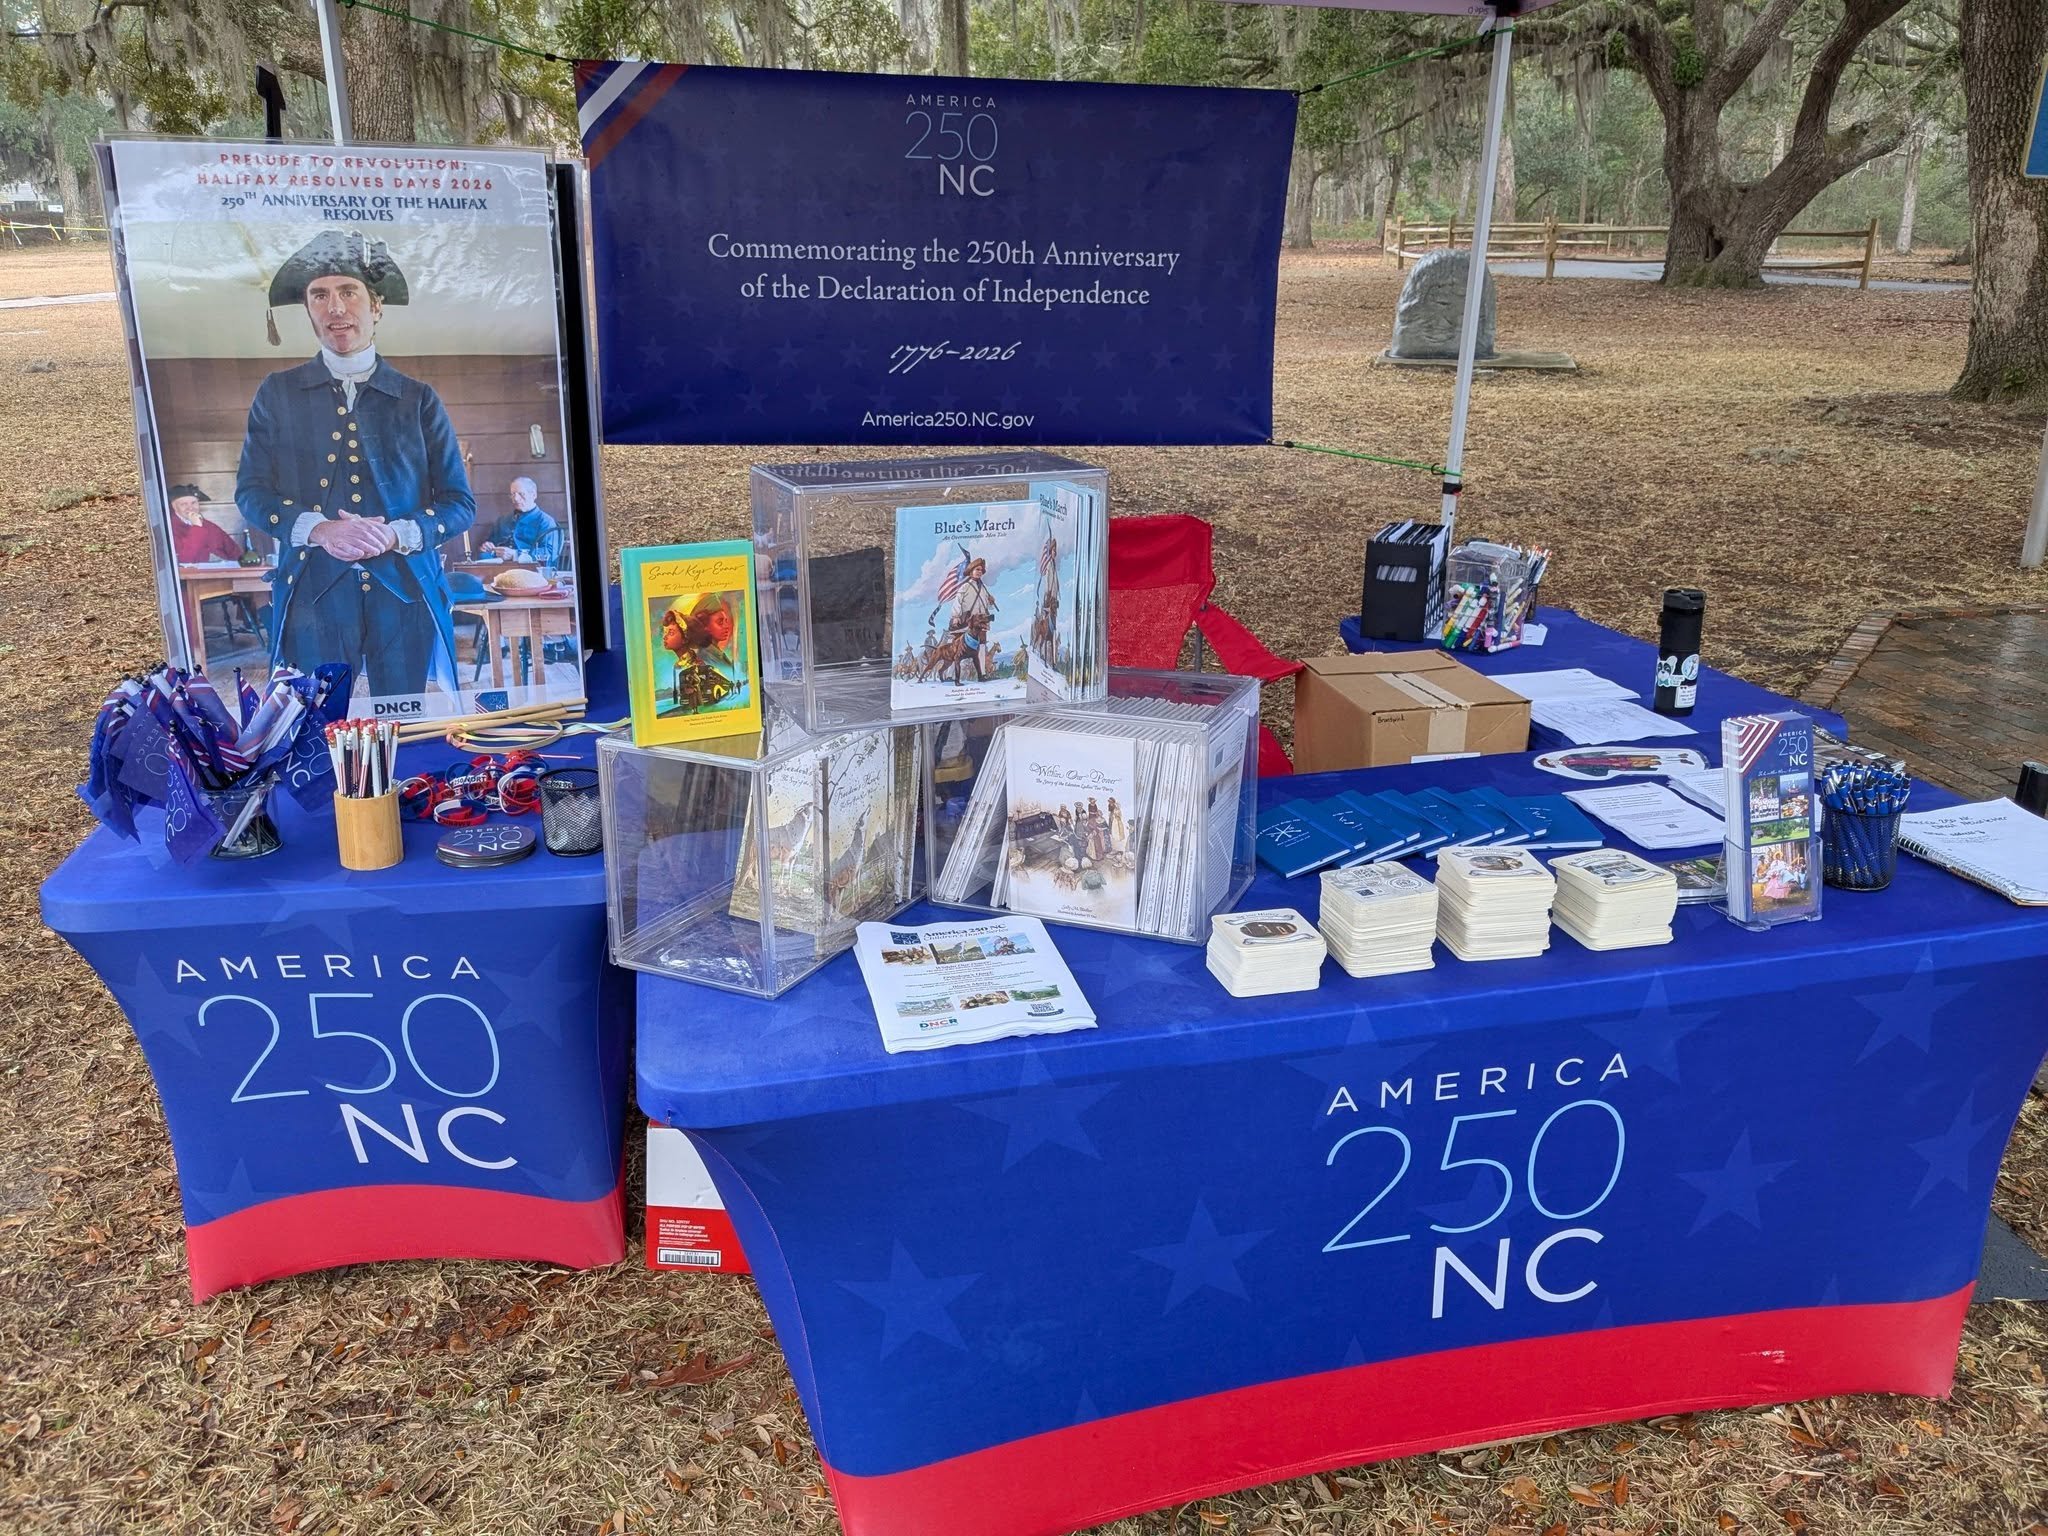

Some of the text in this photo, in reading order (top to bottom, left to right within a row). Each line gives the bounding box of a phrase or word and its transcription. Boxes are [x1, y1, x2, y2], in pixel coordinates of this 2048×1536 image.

[906, 94, 996, 109] AMERICA
[904, 111, 998, 161] 250
[220, 154, 468, 171] PRELUDE TO REVOLUTION:
[197, 173, 493, 191] HALIFAX RESOLVES DAYS 2026
[939, 163, 996, 197] NC
[262, 193, 367, 209] ANNIVERSARY
[371, 196, 392, 209] OF
[394, 196, 424, 209] THE
[427, 197, 488, 210] HALIFAX
[323, 209, 394, 222] RESOLVES
[707, 232, 1181, 276] Commemorating the 250th Anniversary
[740, 274, 1151, 312] of the Declaration of Independence
[861, 411, 1035, 430] America250.NC.gov
[934, 518, 1016, 535] Blue's March
[648, 565, 685, 580] Sarah
[374, 700, 422, 715] DNCR
[1779, 730, 1807, 738] AMERICA
[1778, 735, 1809, 756] 250
[1789, 753, 1808, 767] NC
[279, 750, 311, 788] NC
[1090, 768, 1122, 784] Power
[452, 829, 522, 846] 250
[454, 826, 520, 834] AMERICA
[478, 840, 521, 852] NC
[924, 929, 967, 938] America
[969, 925, 988, 933] 250
[176, 954, 482, 984] AMERICA
[919, 1018, 959, 1028] DNCR
[198, 992, 501, 1104] 250
[1326, 1053, 1630, 1117] AMERICA
[339, 1103, 519, 1170] NC
[1321, 1099, 1626, 1253] 250
[1431, 1228, 1605, 1319] NC
